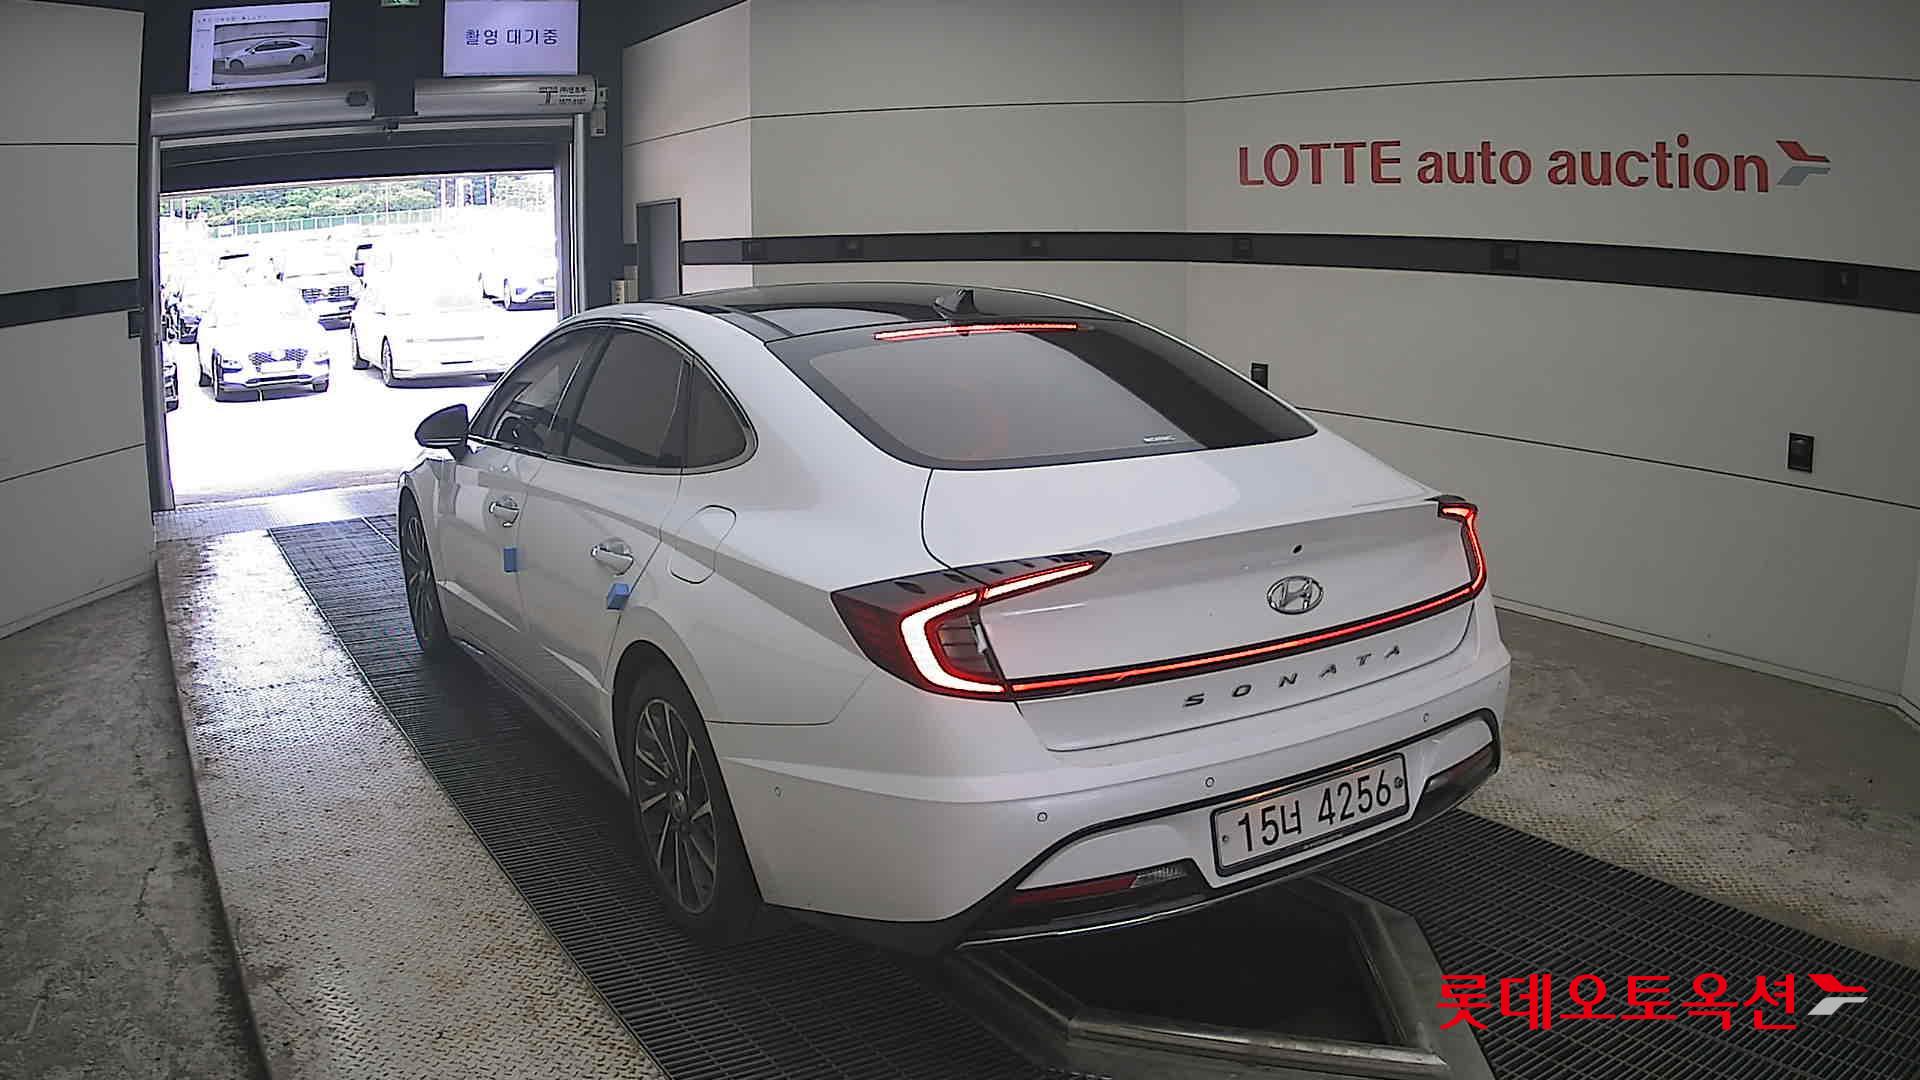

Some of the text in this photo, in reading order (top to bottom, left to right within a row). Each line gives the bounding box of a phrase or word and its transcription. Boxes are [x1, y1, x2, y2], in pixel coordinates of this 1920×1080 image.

[464, 28, 558, 46] 촬영 대기중
[1239, 134, 1769, 193] LOTTE auto auction
[1183, 645, 1401, 708] SONATA
[1238, 769, 1392, 852] 15너 4256
